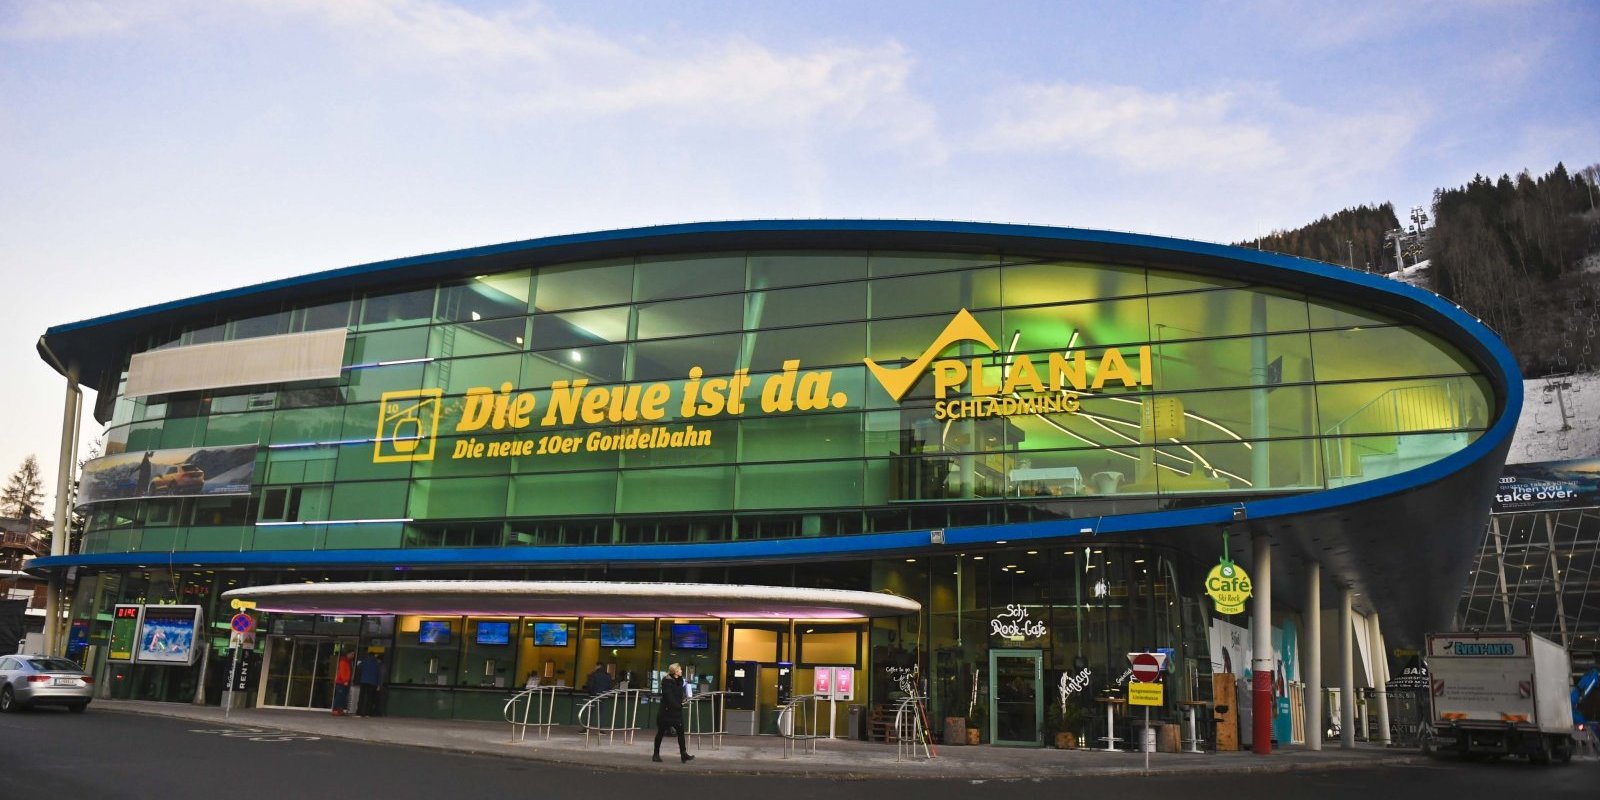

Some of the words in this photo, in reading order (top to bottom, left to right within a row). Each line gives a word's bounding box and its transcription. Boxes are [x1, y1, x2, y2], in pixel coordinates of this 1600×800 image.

[934, 345, 1153, 400] PLANAI
[456, 381, 536, 432] Die
[541, 379, 671, 427] Neue
[681, 366, 751, 418] ist
[761, 359, 848, 413] da.
[387, 404, 399, 414] 10
[934, 393, 1080, 420] SCHLADMING
[452, 438, 485, 459] Die
[487, 439, 534, 457] neue
[537, 434, 583, 455] 10er
[586, 425, 712, 452] Gondelbahn
[1495, 491, 1532, 502] take
[1537, 490, 1578, 500] over.
[1513, 486, 1540, 495] Then
[1542, 485, 1563, 493] you
[1208, 576, 1250, 592] Café
[239, 661, 249, 689] RENT
[1404, 667, 1427, 676] BAR
